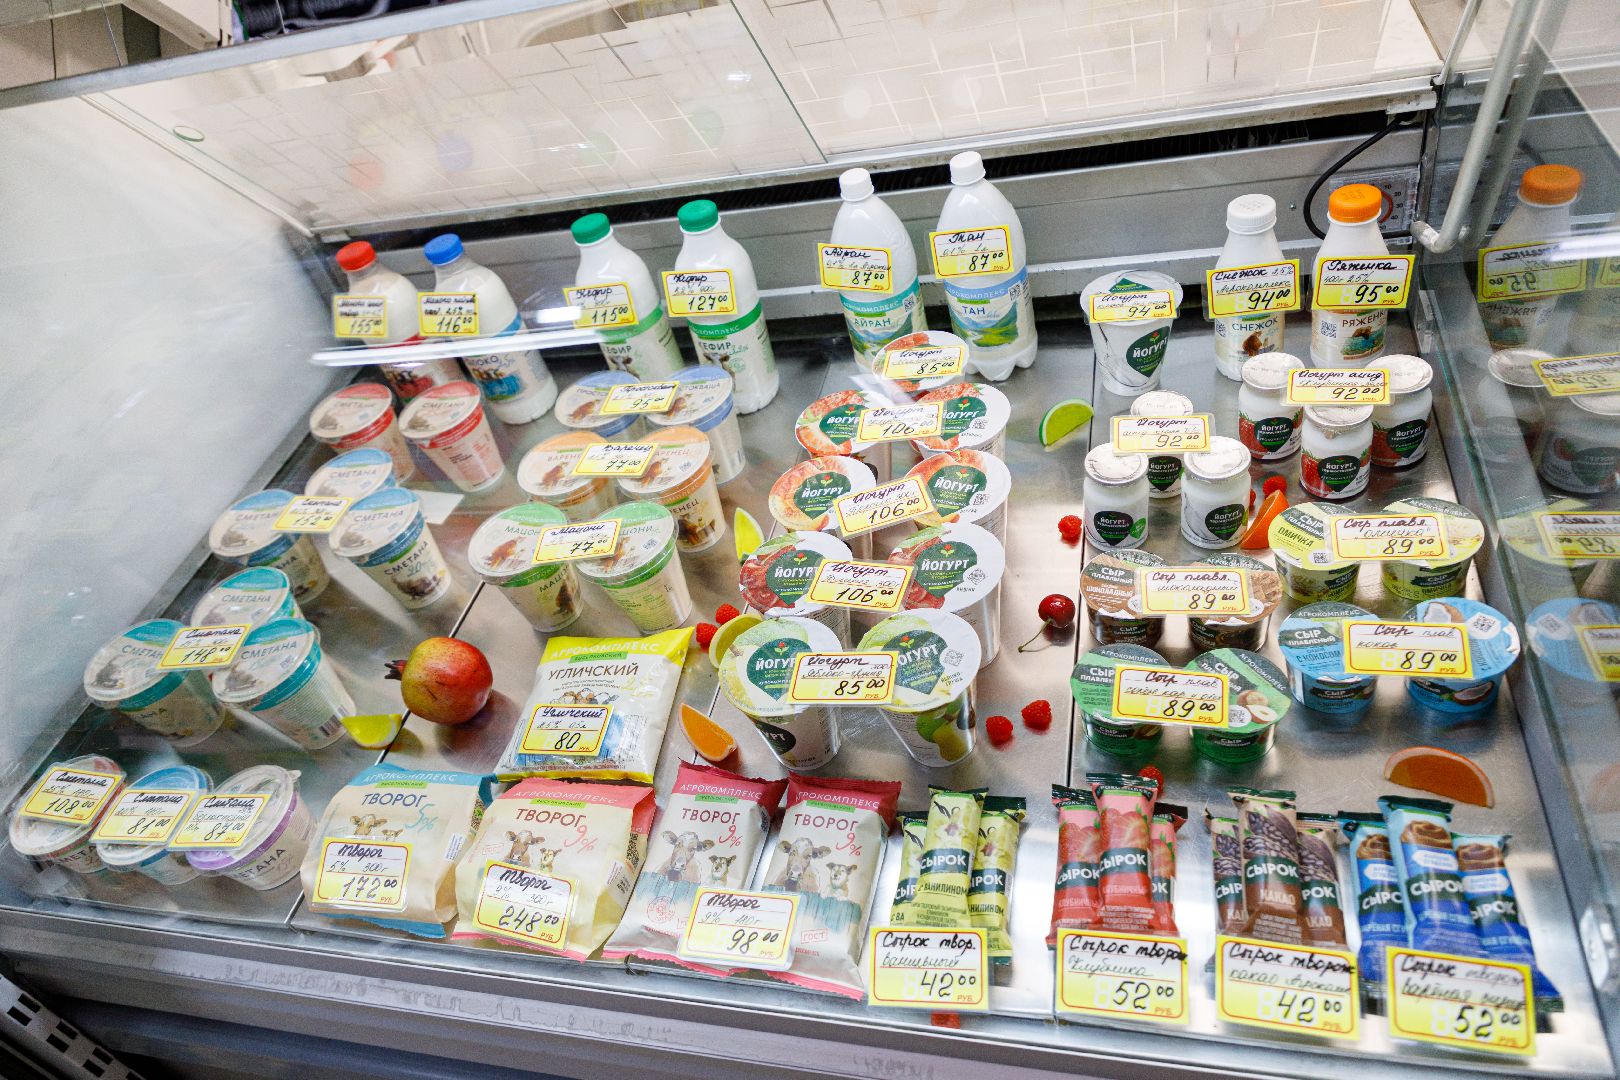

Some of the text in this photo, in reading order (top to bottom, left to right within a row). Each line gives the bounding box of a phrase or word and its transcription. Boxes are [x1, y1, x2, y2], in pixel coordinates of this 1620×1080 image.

[949, 231, 985, 244] Тан
[1327, 259, 1398, 272] Ряженка
[1215, 269, 1268, 281] Снежок
[961, 305, 986, 316] ТАН
[854, 317, 891, 329] АЙРАН
[1231, 316, 1279, 332] СНЕЖОК
[1341, 310, 1387, 328] РЯЖЕНК
[826, 415, 861, 426] ЙОГУР
[801, 486, 844, 499] ЙОГУРТ
[933, 476, 980, 493] ЙОГУРТ
[1299, 514, 1323, 529] СЫР
[504, 525, 541, 537] МАЦОН
[1277, 526, 1315, 548] ОМИЧКА
[921, 558, 970, 571] ЙОГУРТ
[1101, 567, 1126, 576] СЫР
[1297, 607, 1361, 618] АГРОКОМПЛЕКС
[1293, 628, 1322, 639] СЫР
[121, 644, 165, 659] СМЕТАН
[241, 639, 298, 661] СМЕТАНА
[551, 642, 661, 659] АГРОКОМПЛЕКС
[896, 644, 939, 666] ОГУРТ
[1100, 649, 1159, 664] АГРОКОМПЛЕКС
[548, 662, 640, 681] УГЛИЧСКИЙ
[755, 656, 796, 671] ЙОГУР
[1215, 661, 1240, 680] СЫР
[1239, 653, 1287, 692] АГРОКОМПЛЕКС
[555, 731, 582, 750] 80
[363, 772, 459, 783] АГРОКОМПЛЕКС
[512, 791, 618, 804] АГРОКОМПЛЕКС
[679, 783, 763, 800] АГРОКОМПЛЕКС
[360, 793, 428, 808] ТВОРОГ
[404, 804, 440, 833] 5%
[515, 808, 588, 828] ТВОРОГ
[681, 807, 742, 825] ТВОРОГ
[794, 813, 859, 832] ТВОРОГ
[563, 824, 599, 855] 9%
[718, 824, 741, 848] 9%
[835, 832, 863, 857] 9%
[920, 854, 967, 870] СЫРОК
[1099, 853, 1147, 873] СЫРОК
[1246, 862, 1299, 878] СЫРОК
[1056, 867, 1101, 886] СЫРОК
[1260, 889, 1296, 906] КАКАО
[803, 931, 826, 942] ГОСТ
[1069, 935, 1130, 956] Сырок
[956, 994, 974, 1002] РУБ
